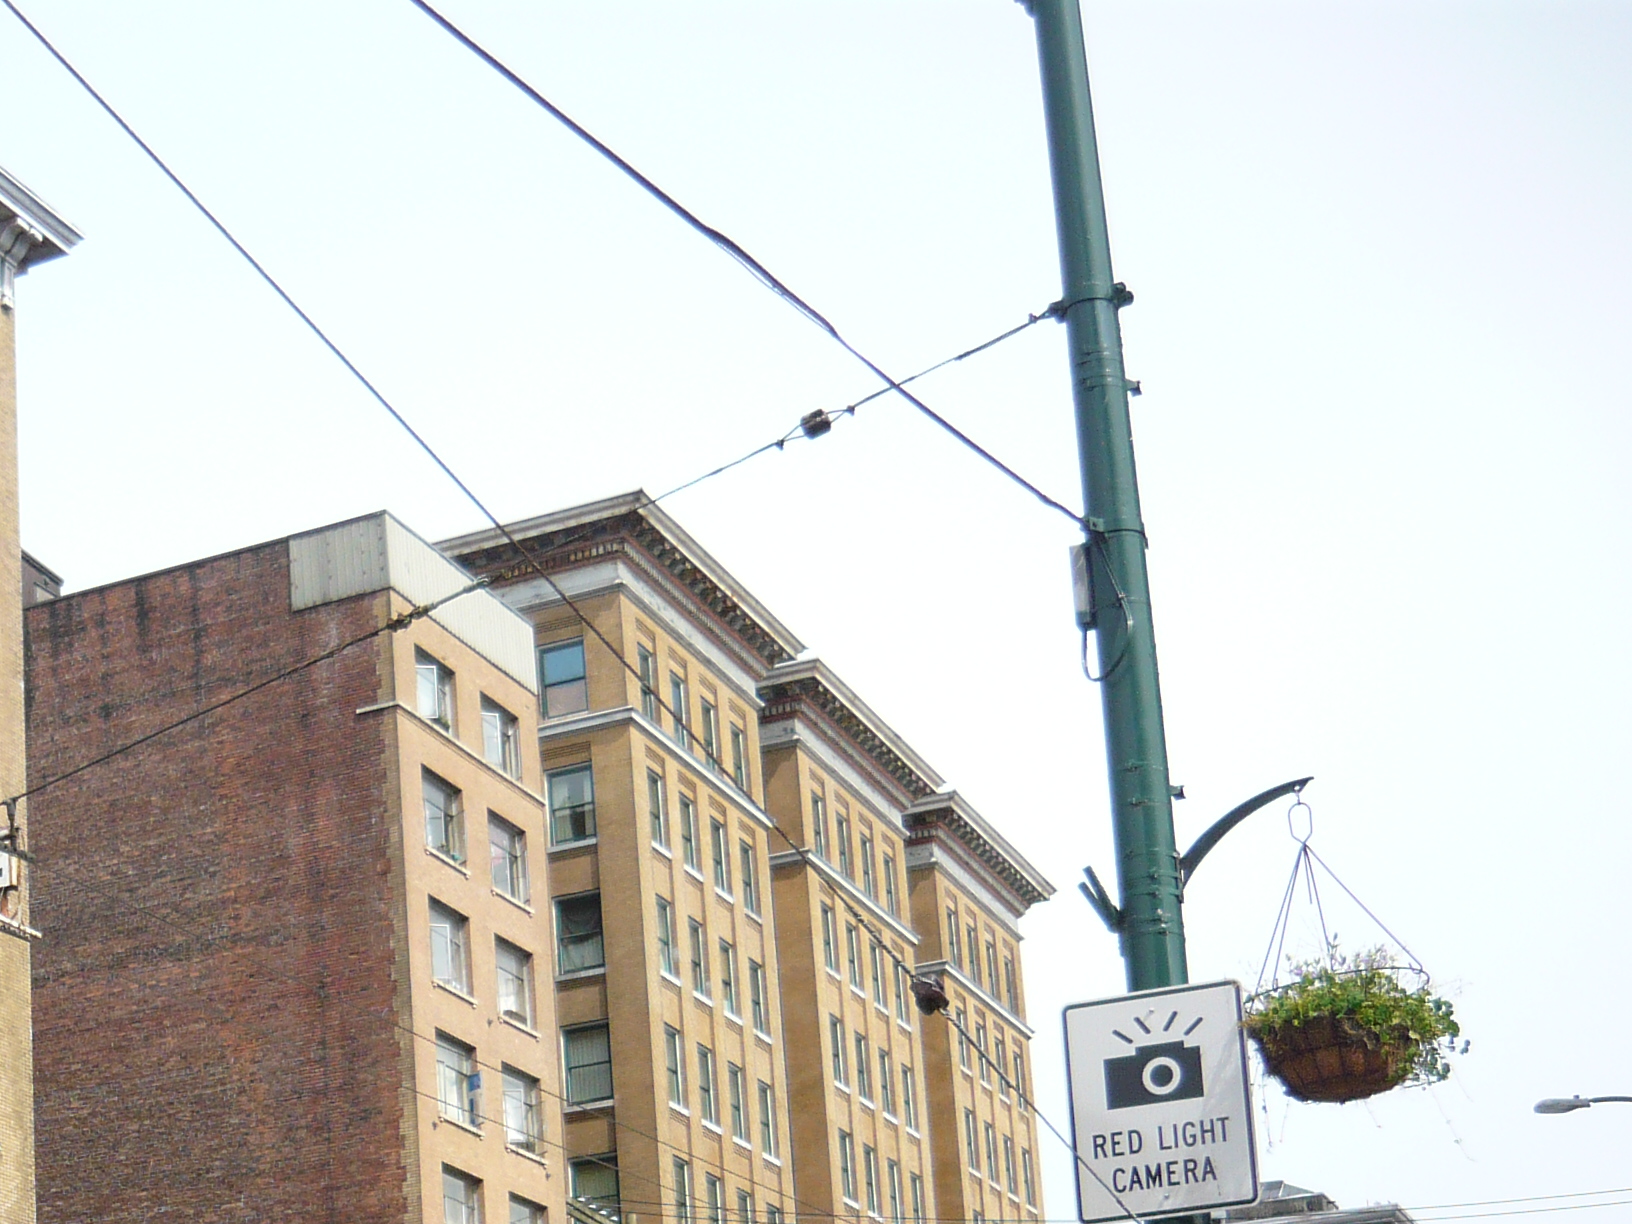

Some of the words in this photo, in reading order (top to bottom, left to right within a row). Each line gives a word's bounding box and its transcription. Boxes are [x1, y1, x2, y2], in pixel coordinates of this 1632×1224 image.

[1092, 1129, 1143, 1160] RED
[1157, 1116, 1230, 1151] LIGHT
[1112, 1156, 1218, 1194] CAMERA
